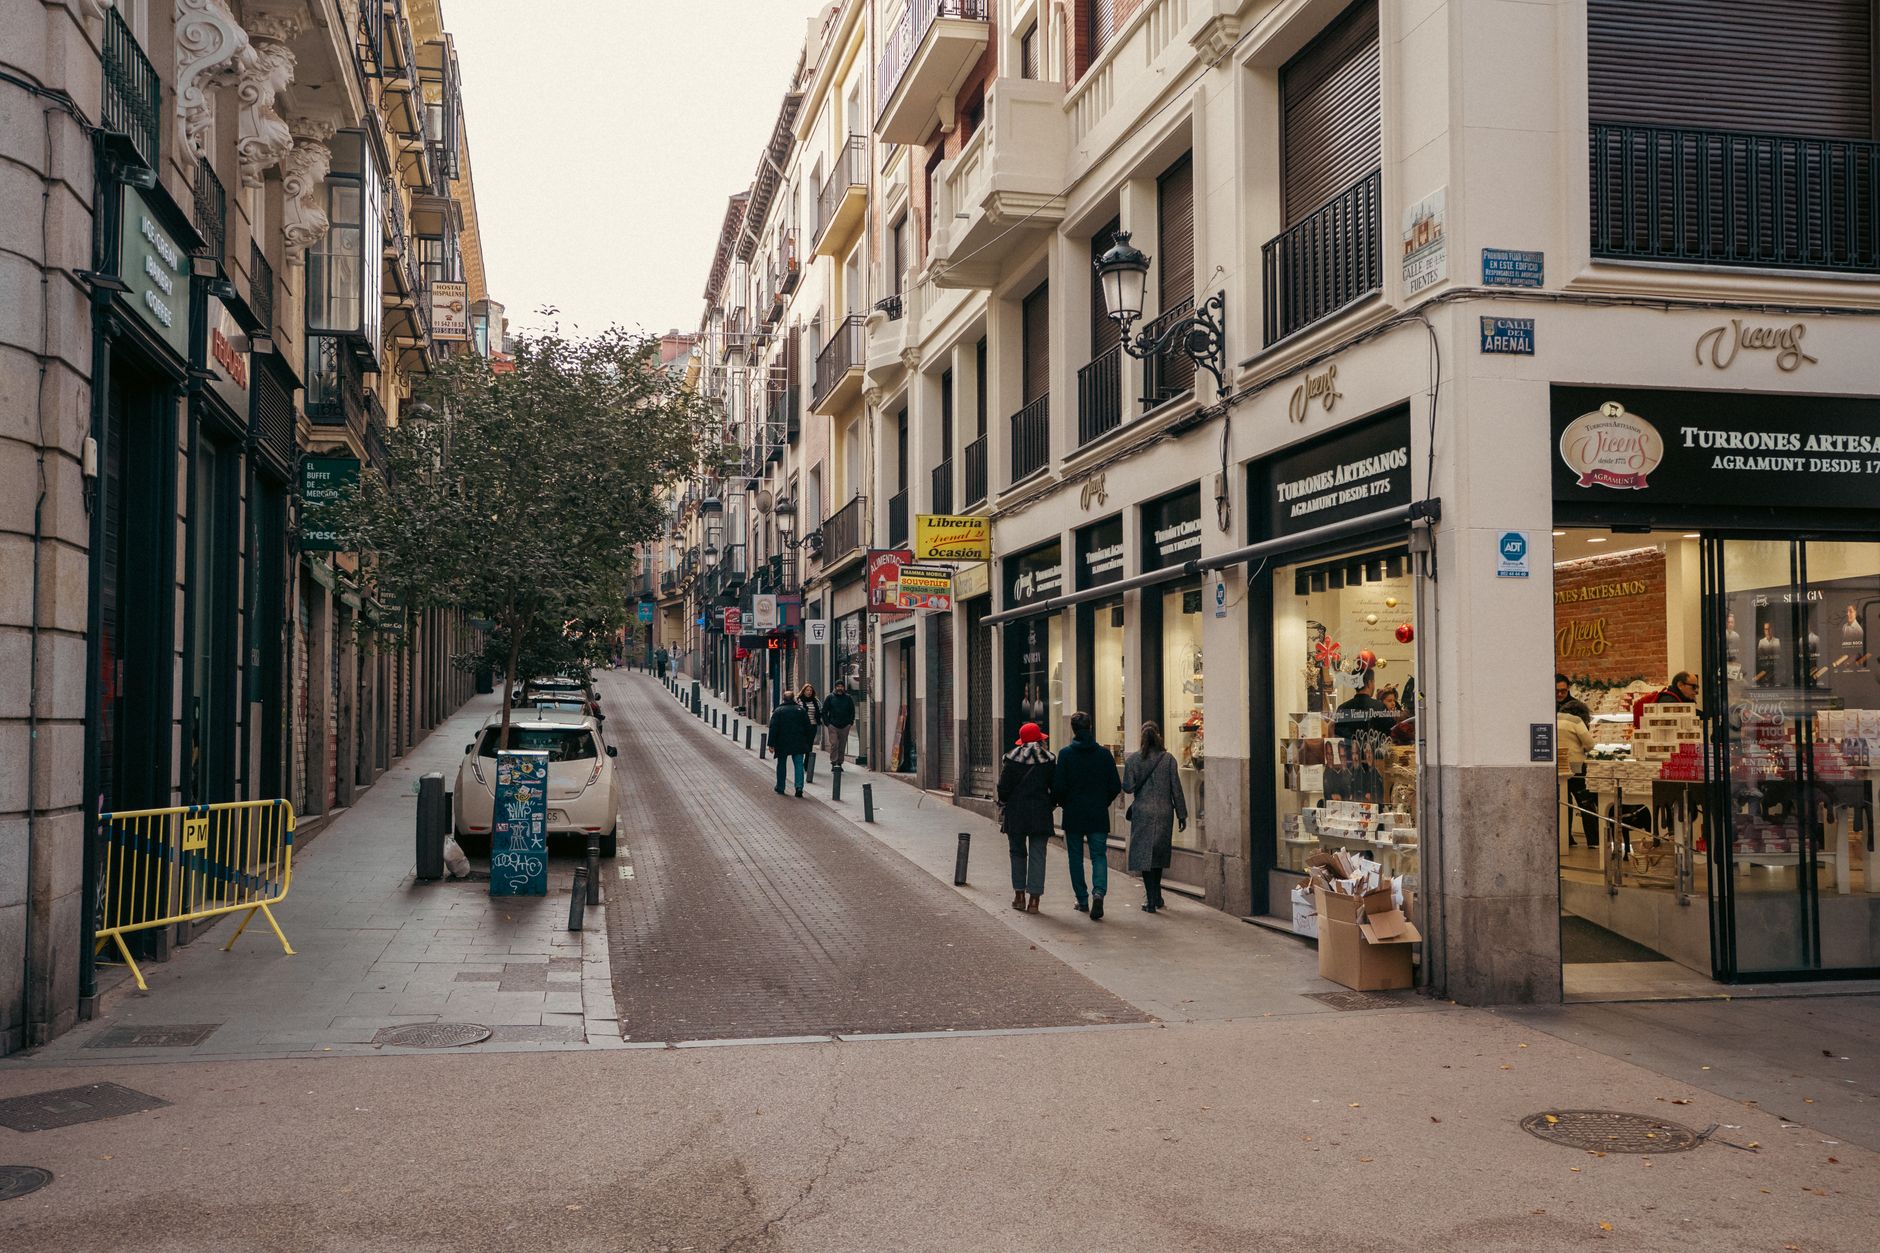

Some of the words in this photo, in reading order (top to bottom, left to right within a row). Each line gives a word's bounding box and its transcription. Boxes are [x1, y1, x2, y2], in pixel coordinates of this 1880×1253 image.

[155, 233, 178, 271] CREAM
[1402, 261, 1423, 281] CALLE
[1490, 260, 1497, 269] EN
[1500, 261, 1513, 270] ESTE
[1515, 262, 1538, 271] EDIFICIO
[145, 255, 172, 296] BAKERY
[1410, 268, 1439, 293] FUENTES
[145, 290, 172, 328] COFFEE
[1497, 320, 1533, 330] CALLE
[1507, 329, 1525, 337] DEL
[1485, 336, 1531, 351] ARENAL
[1695, 319, 1819, 372] Vicens
[1289, 364, 1343, 423] Vicens
[1680, 426, 1801, 451] TURRONES
[1570, 431, 1658, 469] Vicens
[306, 462, 314, 470] EL
[1598, 457, 1614, 465] desde
[1711, 455, 1806, 471] AGRAMUNT
[1809, 458, 1862, 473] DESDE
[1276, 469, 1335, 502] TURRONES
[1334, 447, 1408, 486] ARTESANOS
[1593, 473, 1635, 485] AGRAMUNT
[306, 480, 315, 488] DE
[1290, 492, 1339, 518] AGRAMUNT
[1338, 483, 1369, 504] DESDE
[1370, 478, 1391, 496] 1775
[303, 531, 341, 540] resc
[928, 547, 982, 557] Ocasión
[1504, 542, 1523, 552] ADT
[901, 578, 949, 588] souvenirs
[902, 586, 928, 594] regalos
[1580, 580, 1646, 601] ARTESANOS
[1556, 617, 1613, 657] Vicens
